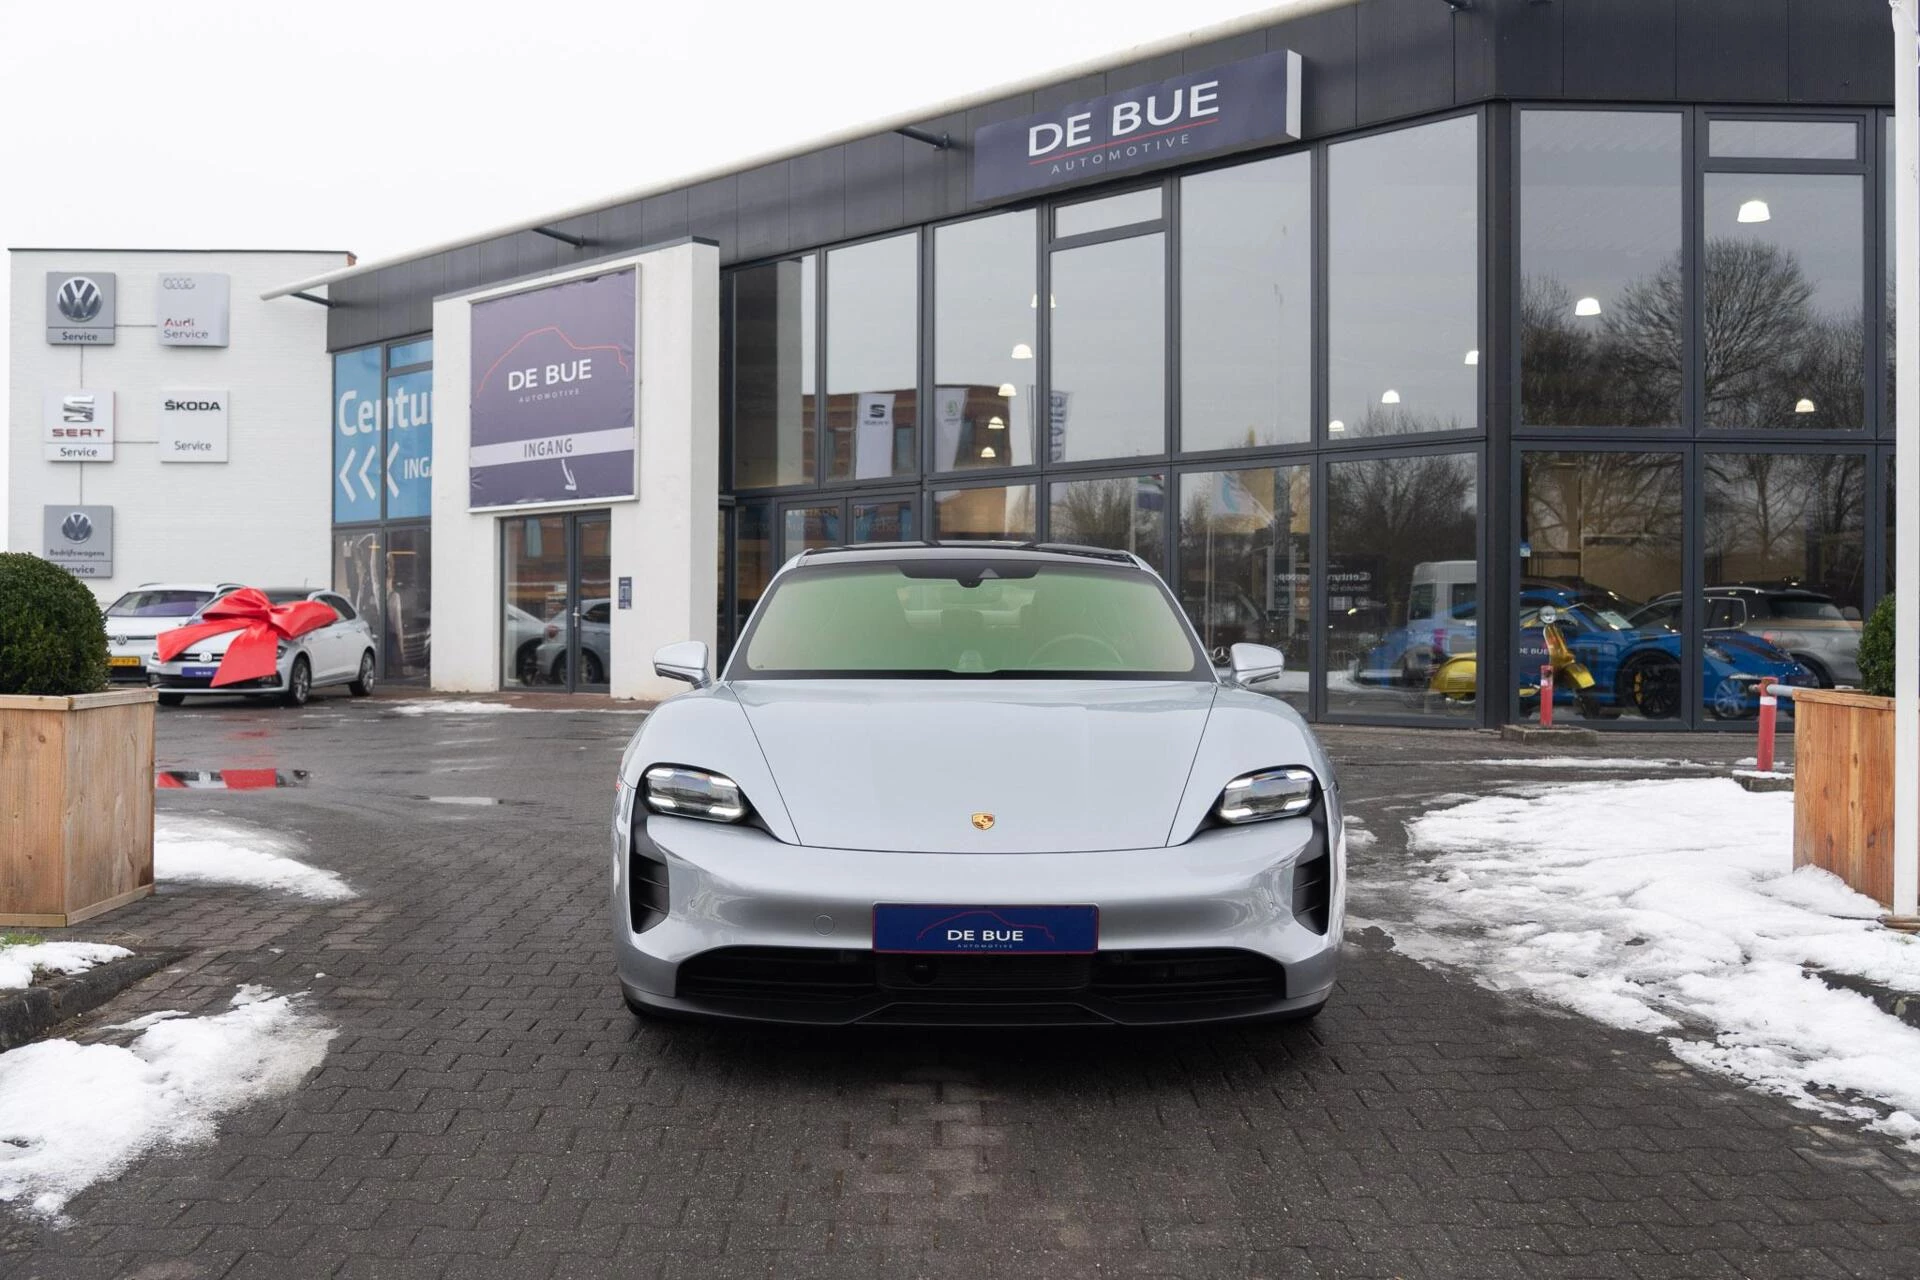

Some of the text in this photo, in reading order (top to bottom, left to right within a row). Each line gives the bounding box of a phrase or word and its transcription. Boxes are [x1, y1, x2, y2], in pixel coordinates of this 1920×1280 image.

[1029, 80, 1219, 157] DE BUE
[1051, 133, 1191, 174] AUTOMOTIVE
[164, 318, 195, 327] Audi
[62, 331, 98, 341] Service
[164, 329, 208, 339] Service
[508, 359, 592, 391] DE BUE
[518, 388, 580, 403] AUTOMOTIVE
[164, 400, 221, 411] ŠKODA
[338, 387, 433, 436] Centu
[60, 447, 97, 457] Service
[174, 441, 212, 451] Service
[524, 438, 573, 458] INGANG
[404, 458, 433, 479] ING
[947, 930, 1024, 941] DE BUE
